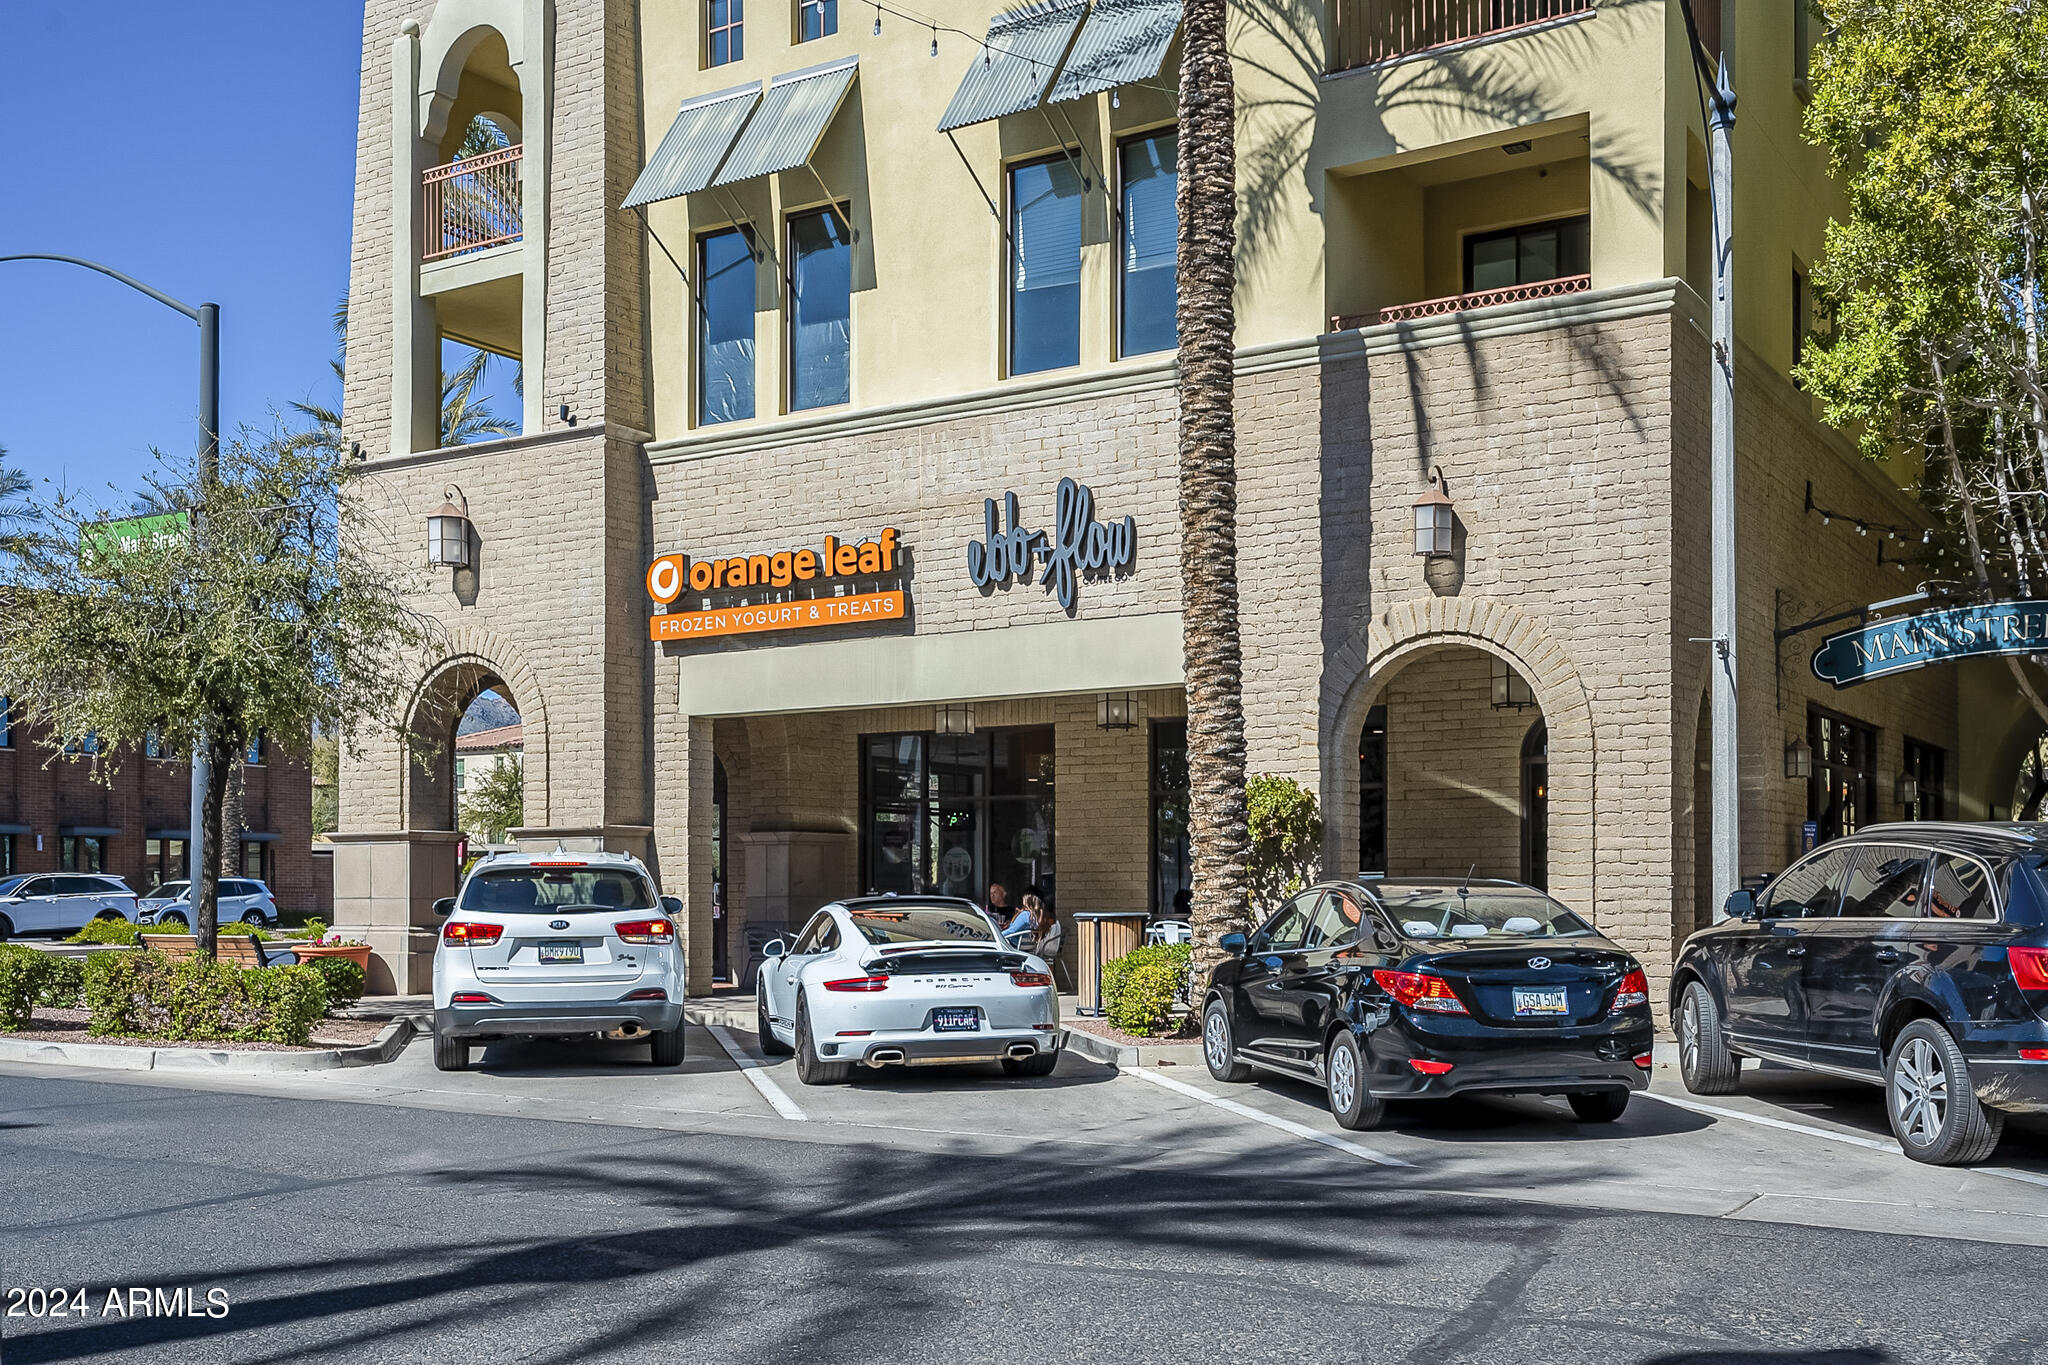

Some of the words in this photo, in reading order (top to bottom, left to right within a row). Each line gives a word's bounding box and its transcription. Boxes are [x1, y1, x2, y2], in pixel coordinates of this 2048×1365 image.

[689, 549, 816, 591] orange
[825, 528, 896, 577] leaf
[968, 490, 1042, 587] ebb
[1040, 476, 1132, 609] flow
[659, 614, 726, 635] FROZEN
[732, 606, 803, 627] YOGURT
[809, 605, 820, 620] &
[827, 598, 895, 619] TREATS
[1851, 622, 1950, 668] MAIN
[1956, 612, 2048, 646] STRE
[1522, 993, 1542, 1008] GSA
